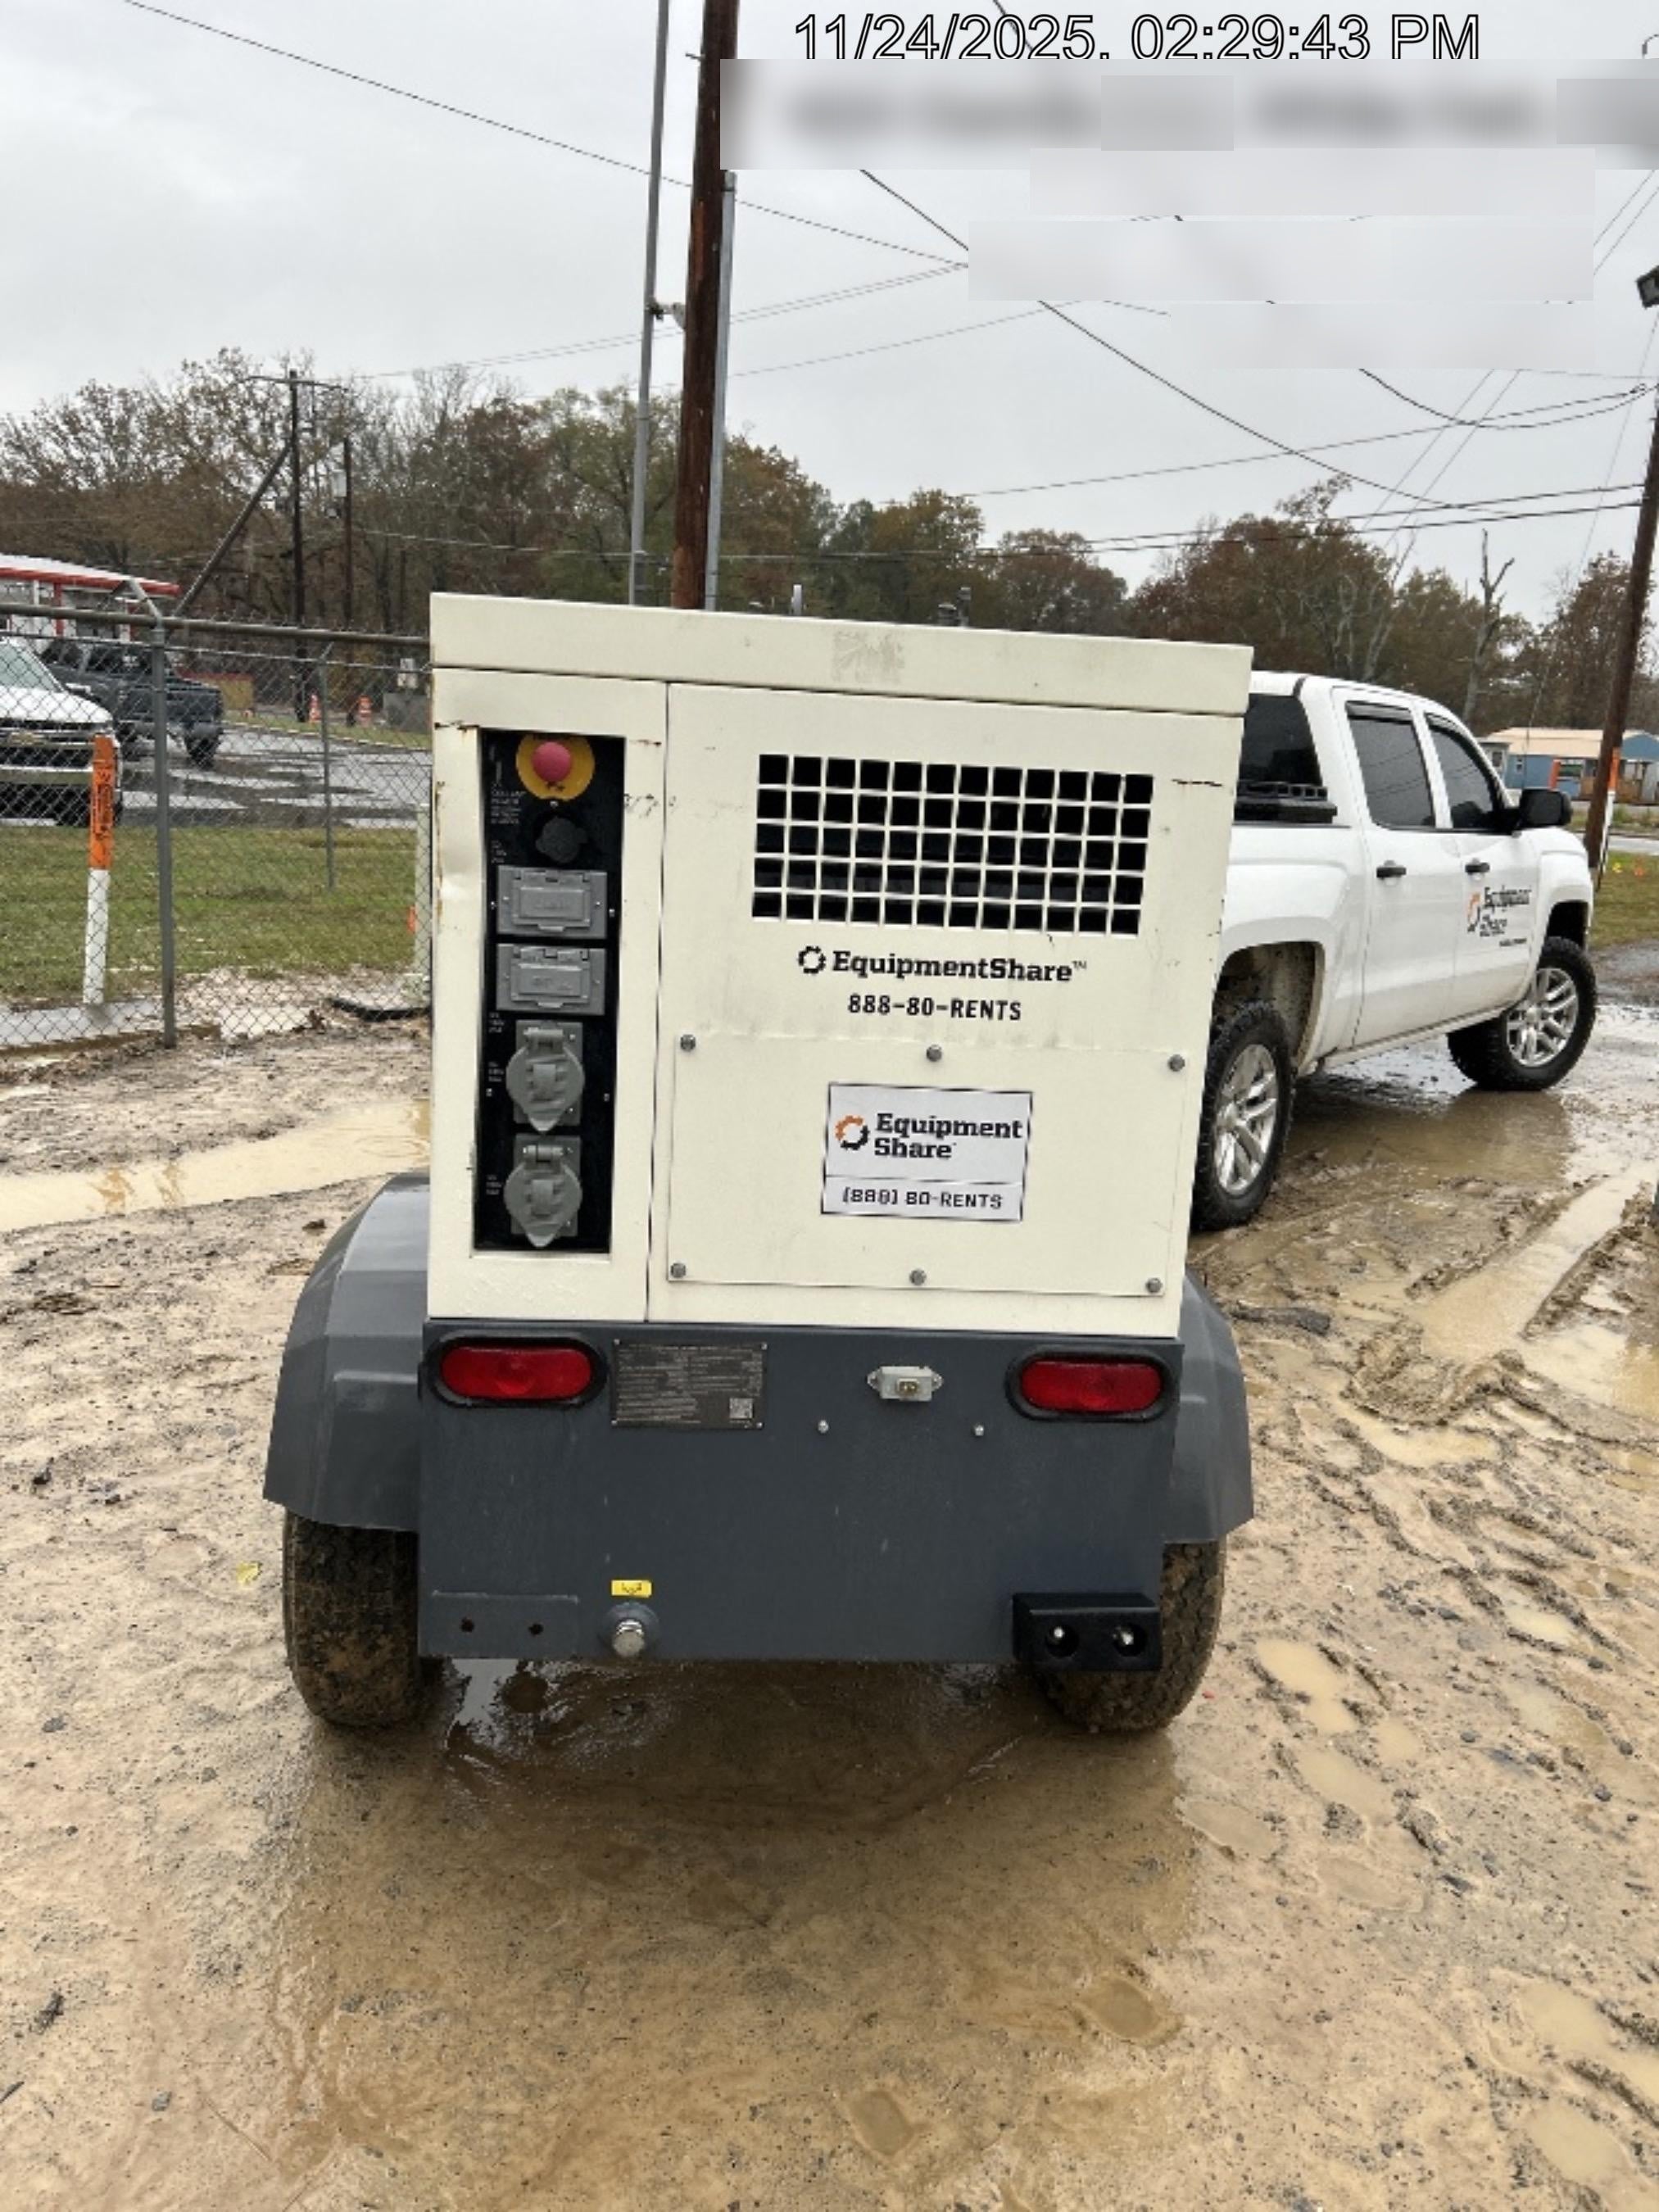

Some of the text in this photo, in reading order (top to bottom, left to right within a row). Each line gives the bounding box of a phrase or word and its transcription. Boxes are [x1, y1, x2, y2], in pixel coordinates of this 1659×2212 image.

[847, 993, 1022, 1021] 888-80-RENTS
[875, 1113, 1023, 1139] Equipment
[873, 1137, 953, 1159] Share
[905, 1190, 1003, 1210] 80-RENTS
